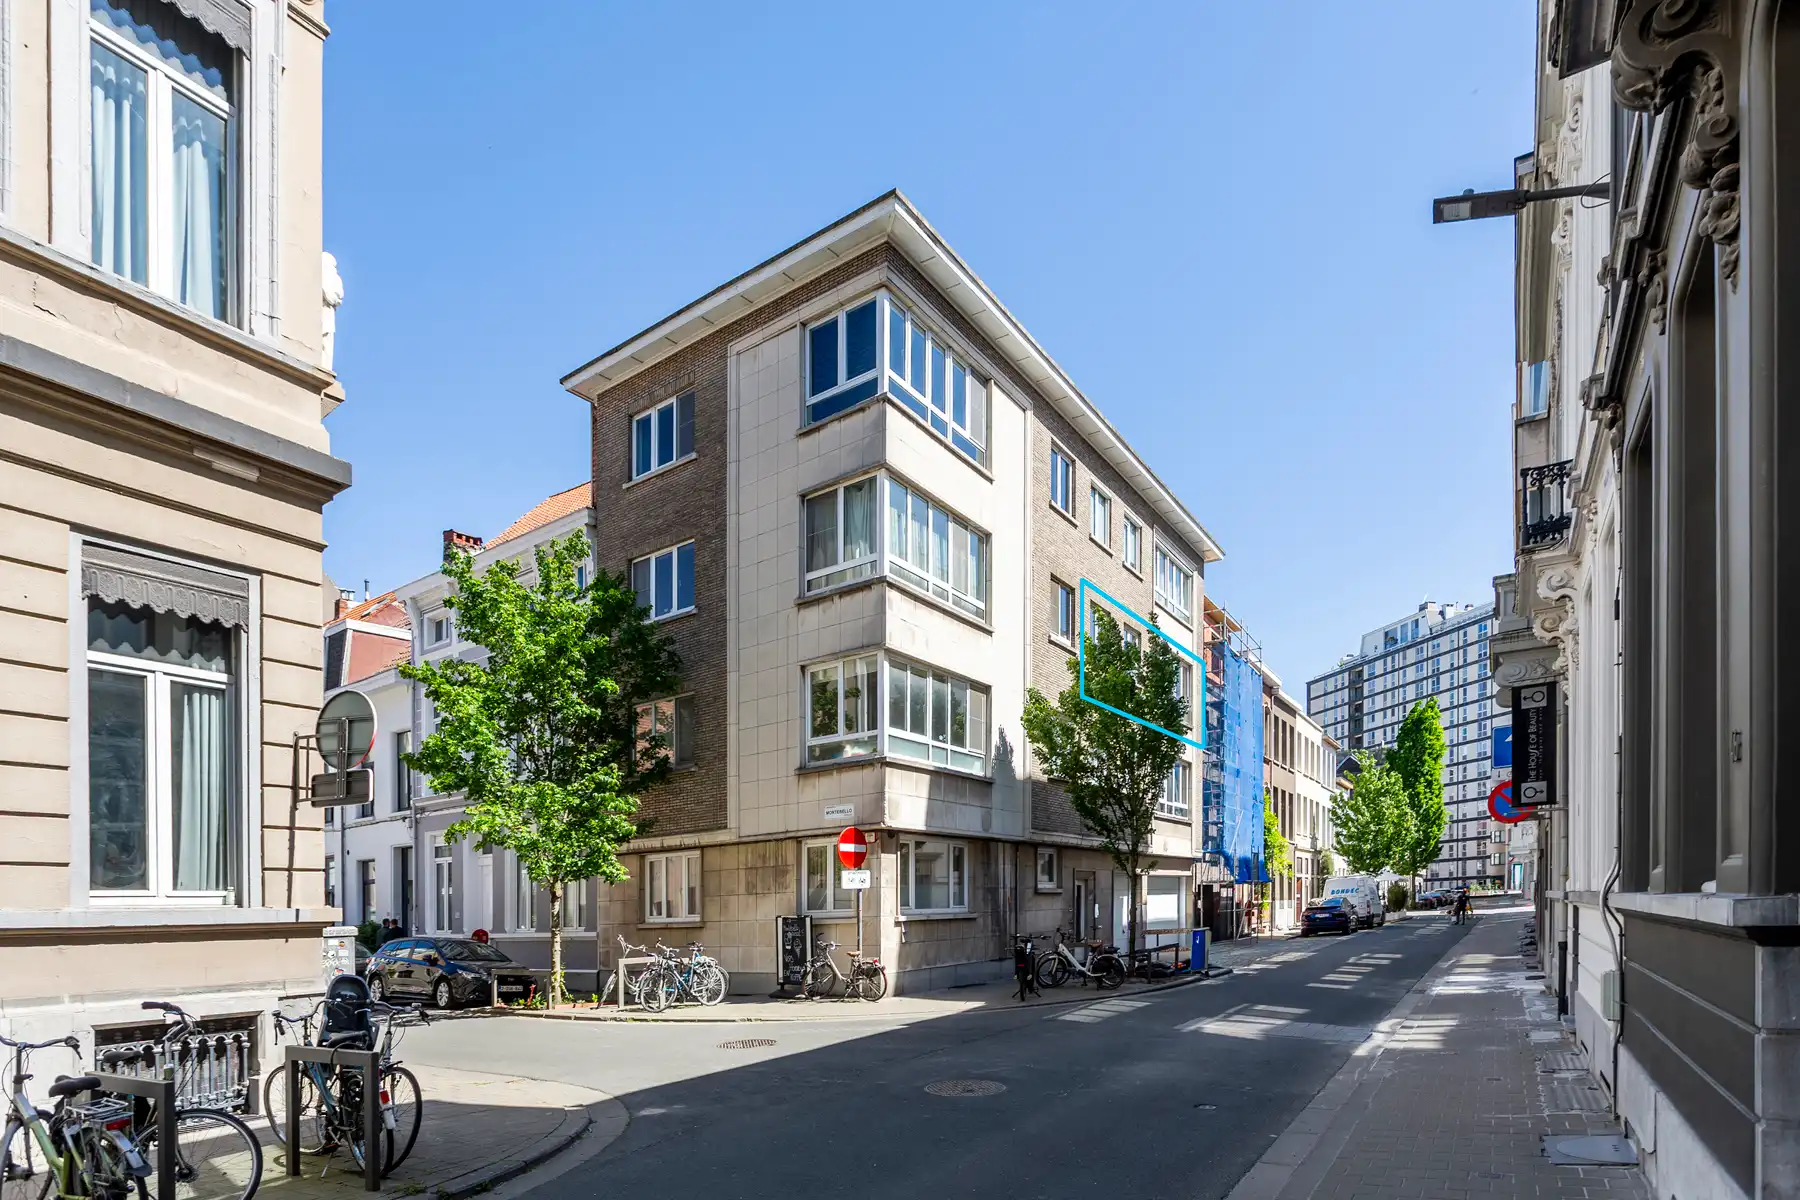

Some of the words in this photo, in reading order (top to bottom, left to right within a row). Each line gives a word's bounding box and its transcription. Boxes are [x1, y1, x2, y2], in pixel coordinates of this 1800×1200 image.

[1528, 709, 1537, 733] BEAUTY
[1529, 734, 1537, 743] OF
[1528, 744, 1540, 769] HOUSE
[1528, 770, 1537, 782] THE
